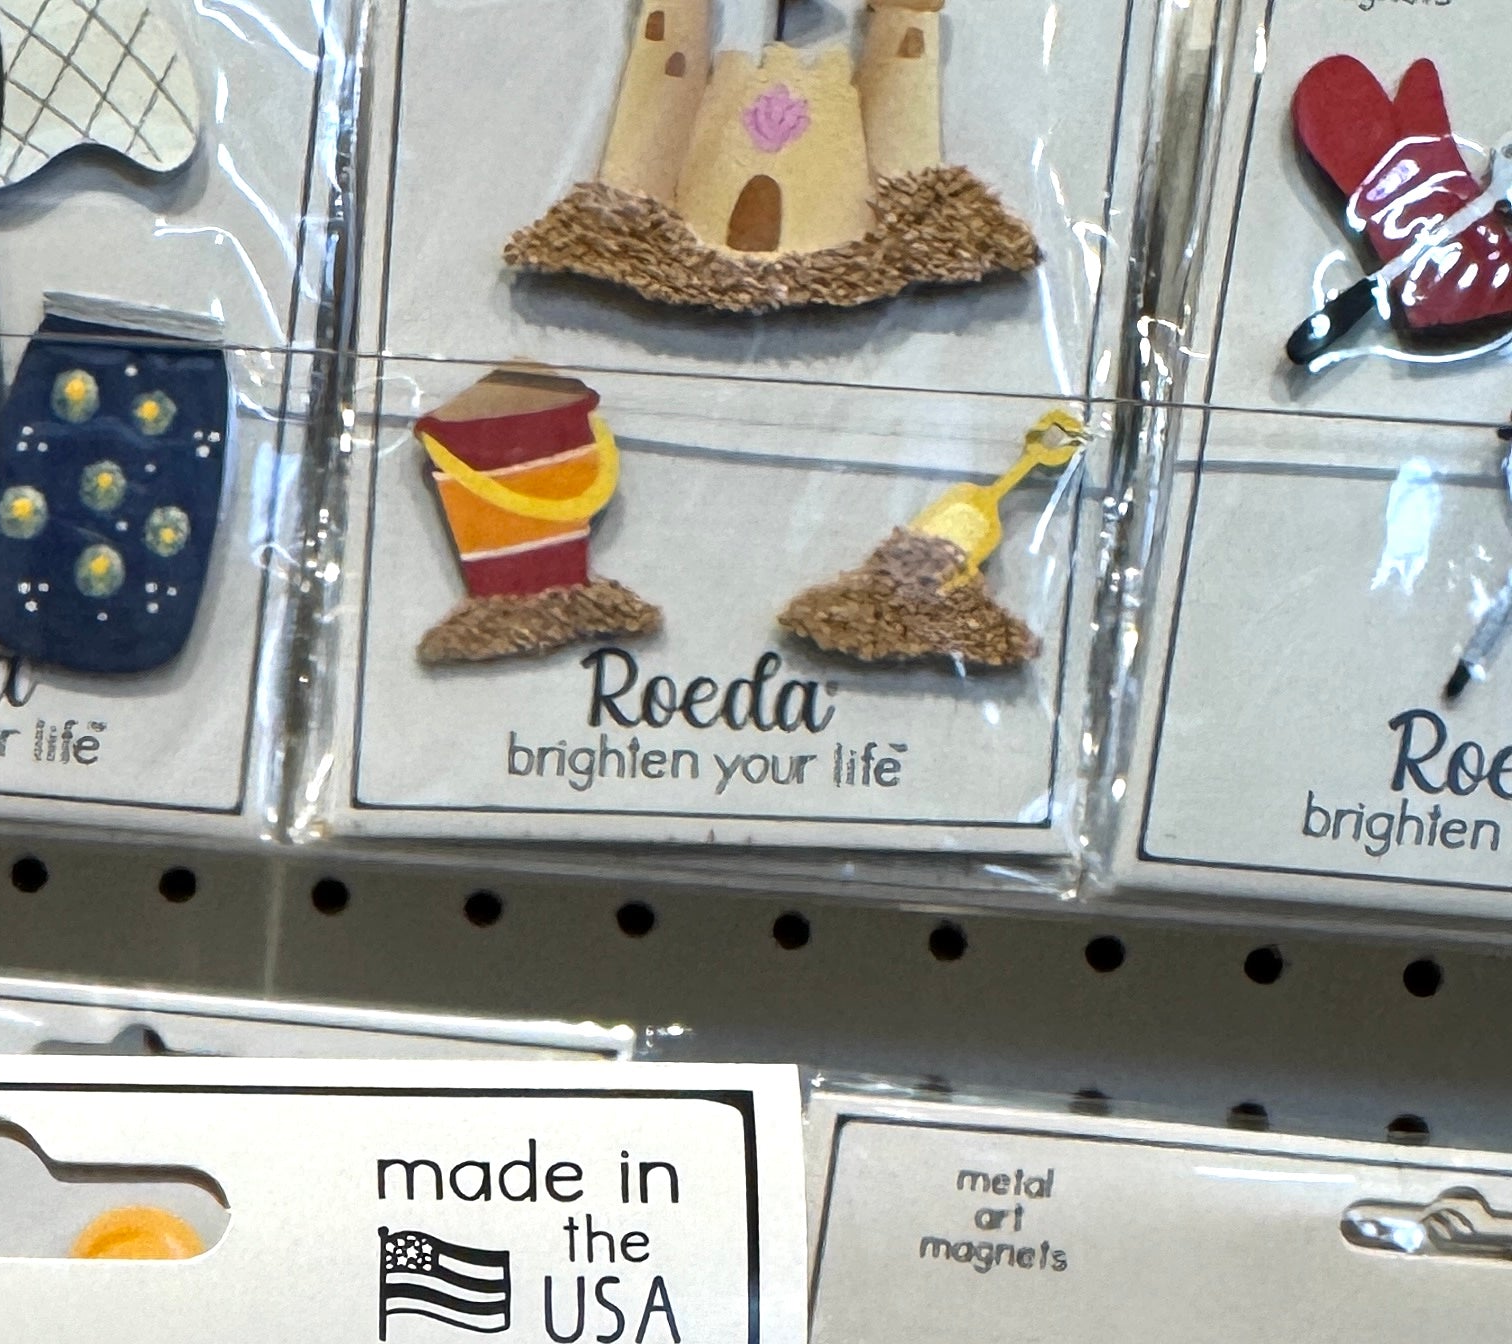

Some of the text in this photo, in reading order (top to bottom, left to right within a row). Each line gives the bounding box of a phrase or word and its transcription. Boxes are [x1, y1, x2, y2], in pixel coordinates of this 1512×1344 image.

[580, 646, 838, 734] Roeda
[507, 730, 700, 792] brighten
[713, 753, 818, 796] your
[1300, 789, 1501, 858] brighten
[376, 1138, 680, 1204] made in
[956, 1168, 1055, 1200] metal
[562, 1213, 650, 1264] the
[973, 1202, 1025, 1233] art
[919, 1232, 1069, 1274] magnets
[544, 1275, 682, 1344] USA
